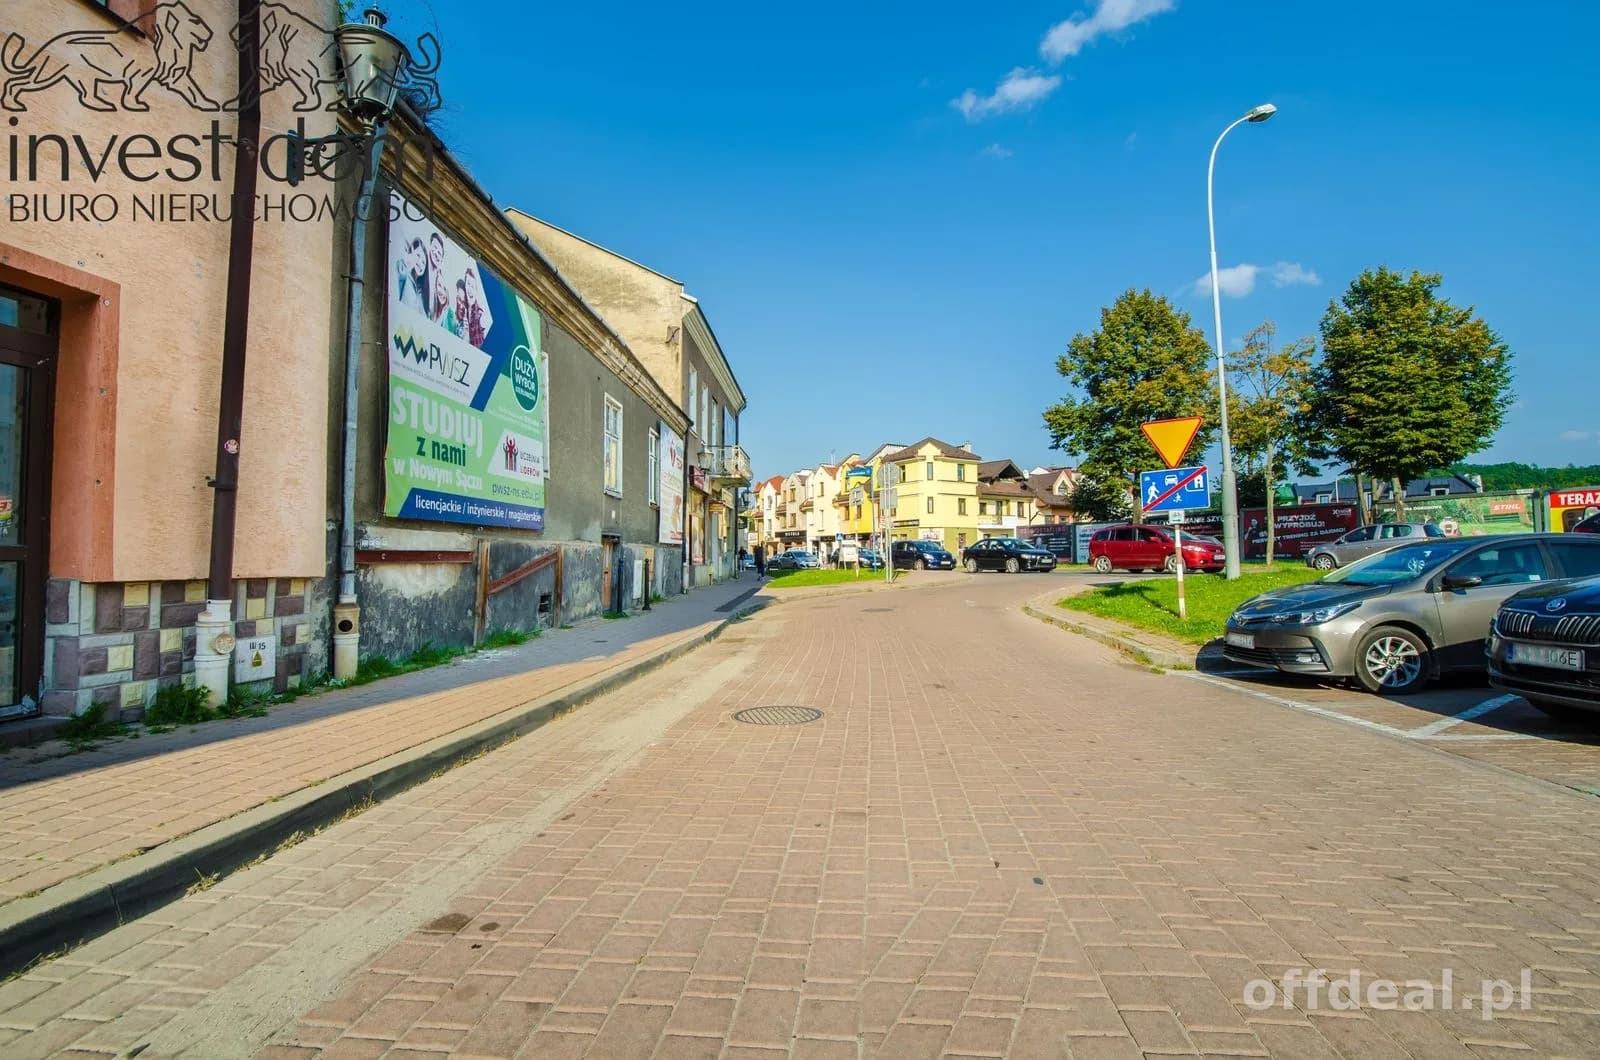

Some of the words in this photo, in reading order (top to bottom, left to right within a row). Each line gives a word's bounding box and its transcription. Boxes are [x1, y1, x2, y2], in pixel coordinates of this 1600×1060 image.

[515, 356, 536, 379] DUŻY
[393, 386, 483, 459] STUDIUJ
[431, 440, 466, 467] nami
[409, 459, 453, 487] Nowym
[415, 494, 462, 514] licencjackie
